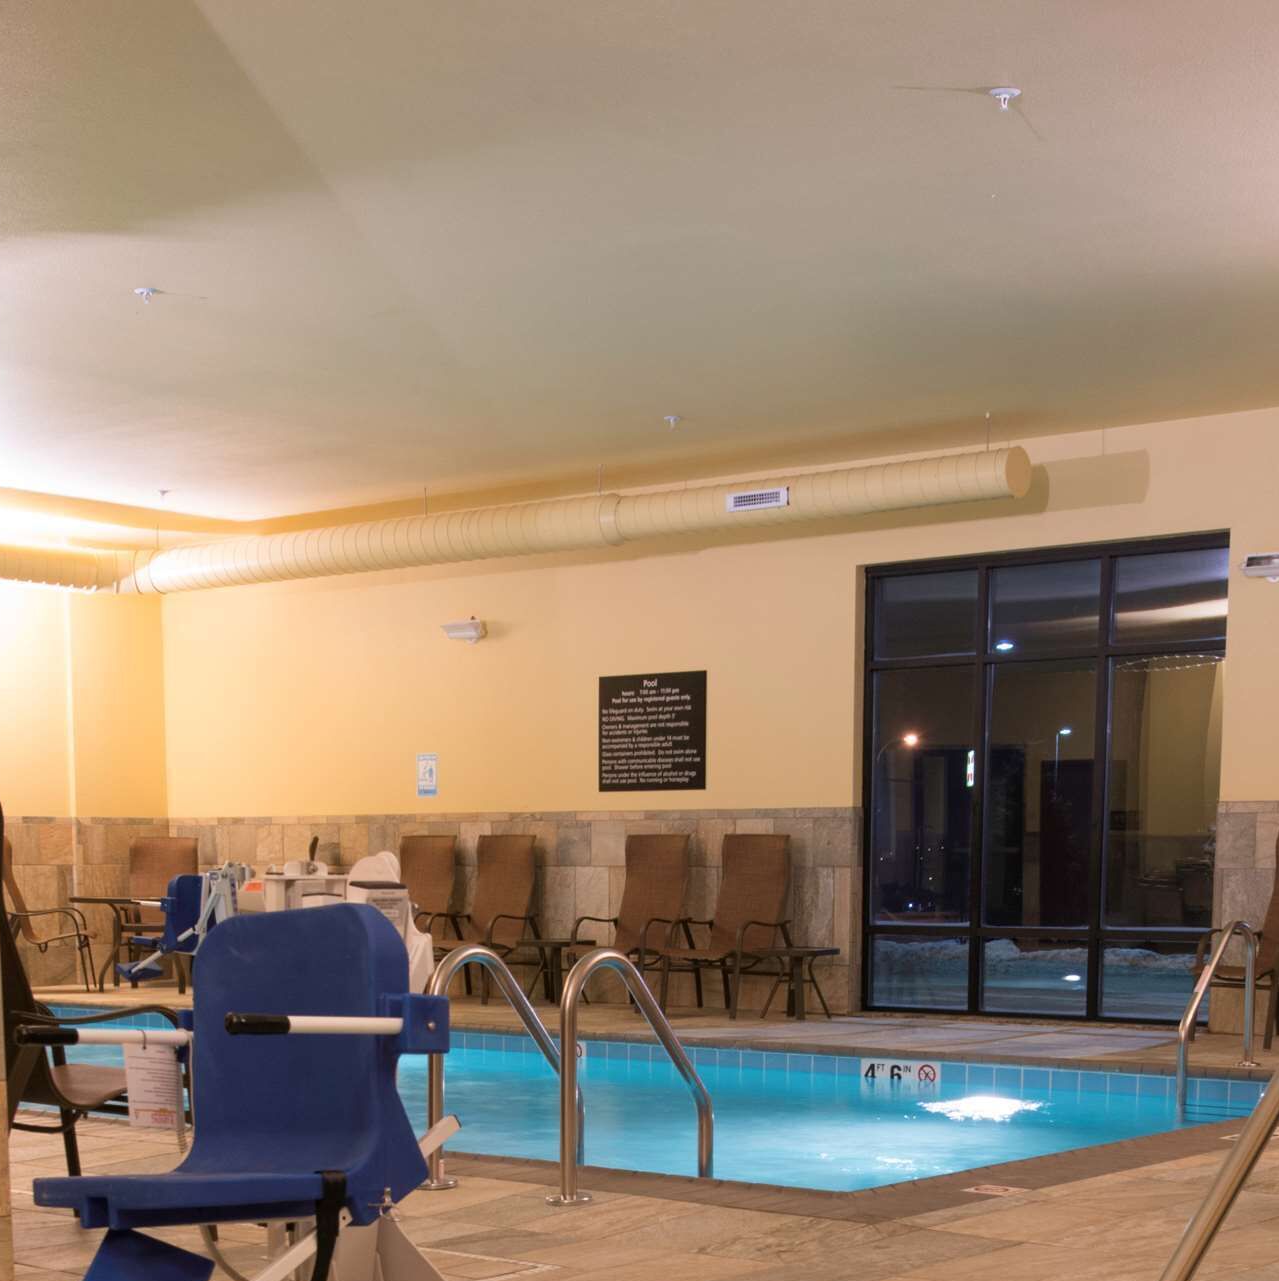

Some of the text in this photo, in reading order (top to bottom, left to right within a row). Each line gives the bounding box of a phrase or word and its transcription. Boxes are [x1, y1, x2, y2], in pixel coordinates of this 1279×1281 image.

[864, 1063, 876, 1079] 4
[877, 1064, 885, 1072] FT
[903, 1065, 911, 1073] IN
